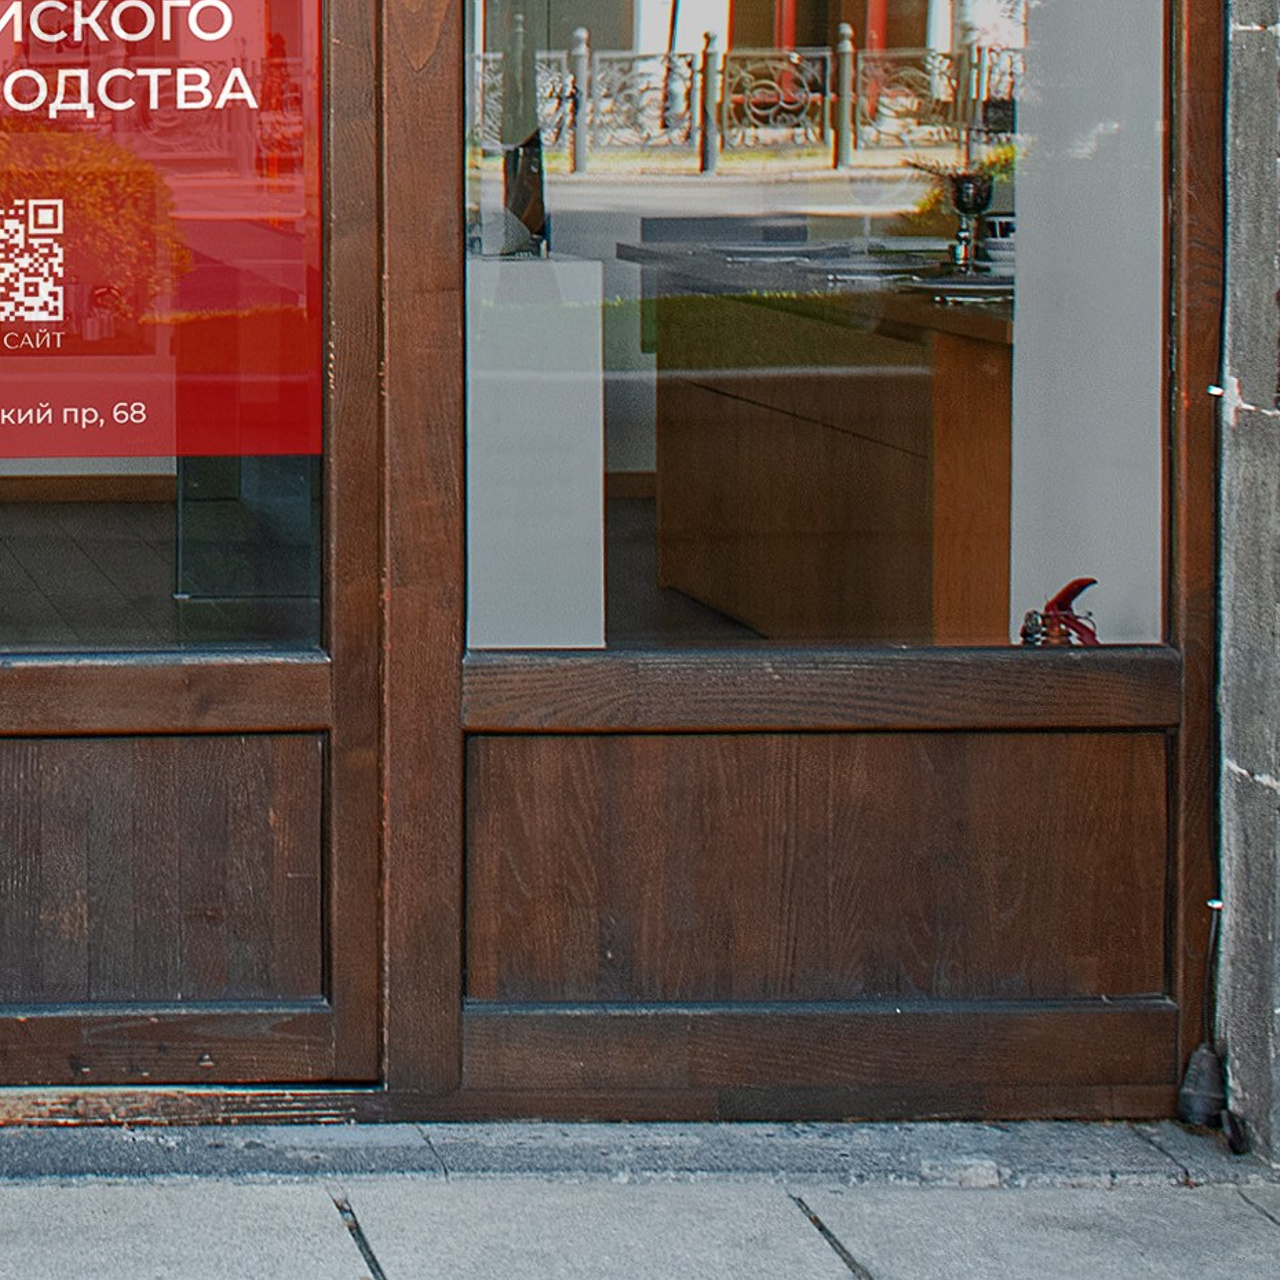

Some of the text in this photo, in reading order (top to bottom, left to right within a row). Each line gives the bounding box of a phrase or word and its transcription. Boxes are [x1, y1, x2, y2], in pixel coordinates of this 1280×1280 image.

[3, 329, 66, 349] САЙТ
[62, 407, 106, 429] пр,
[112, 401, 148, 424] 68
